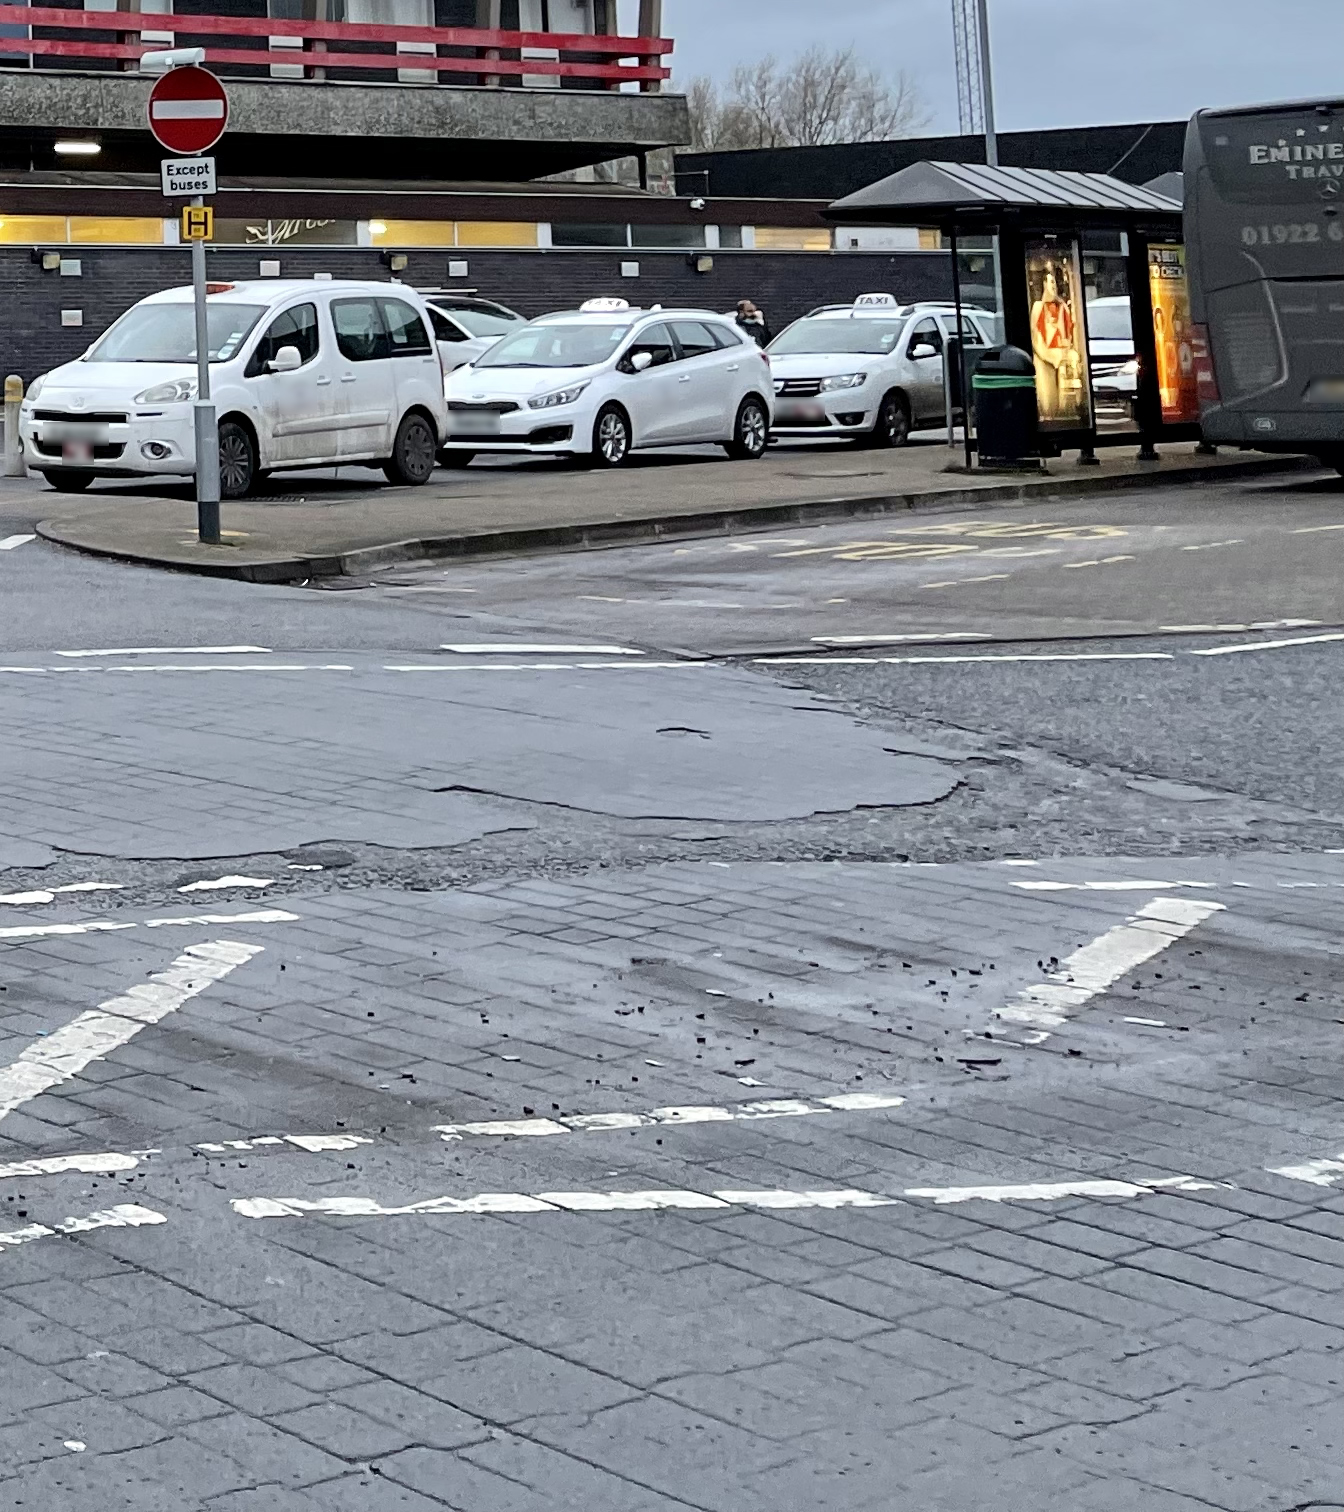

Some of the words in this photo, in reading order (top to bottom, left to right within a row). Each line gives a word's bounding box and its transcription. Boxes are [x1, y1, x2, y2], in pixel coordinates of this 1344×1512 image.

[166, 163, 210, 177] Except
[170, 180, 208, 191] buses
[187, 211, 208, 236] H
[1241, 223, 1320, 245] 01922
[859, 297, 889, 305] TAXI
